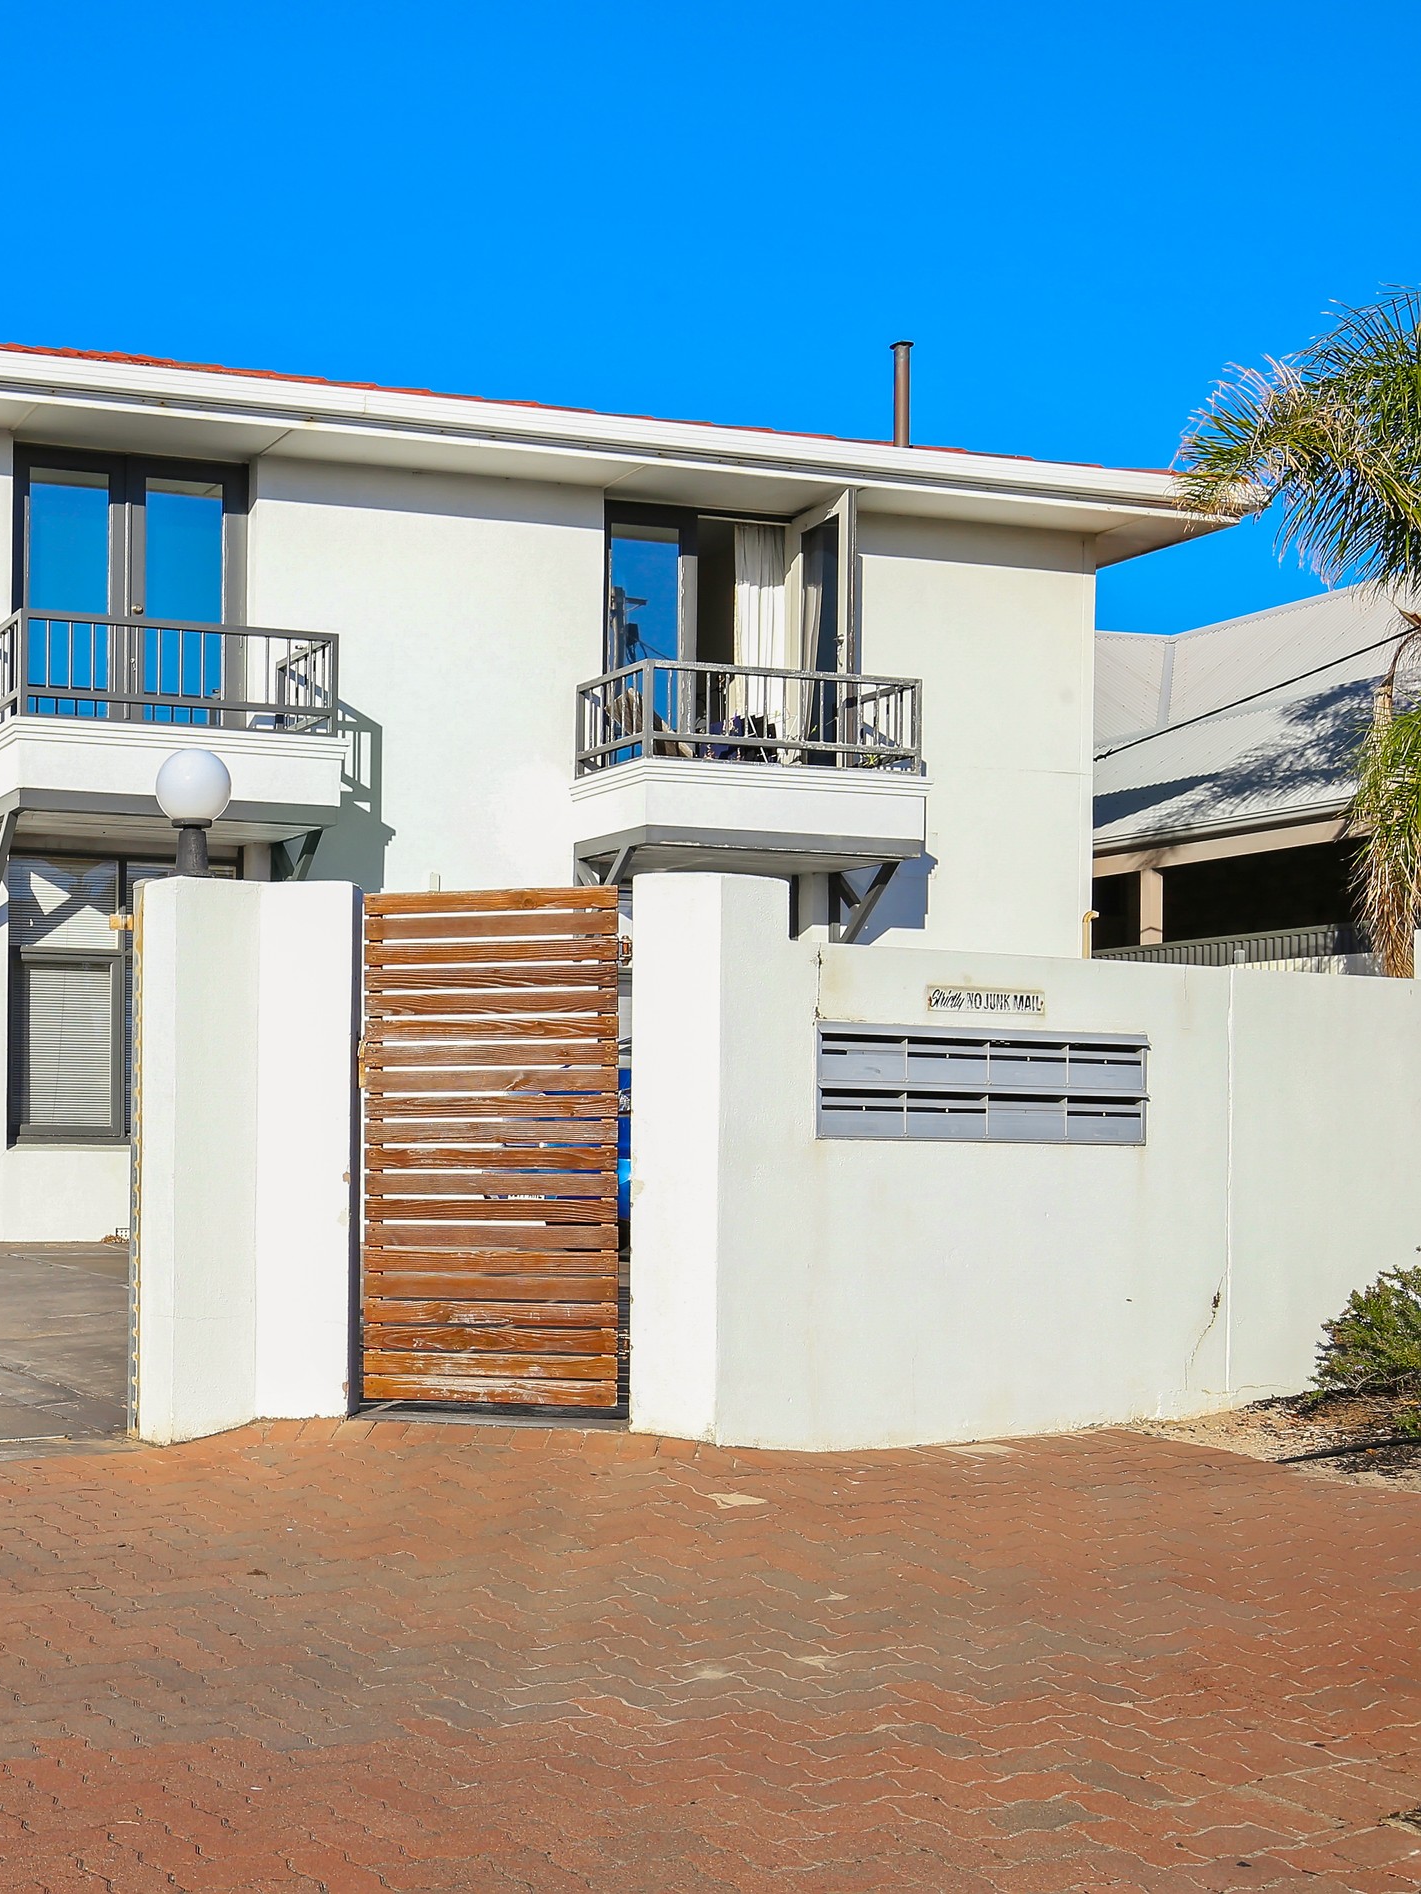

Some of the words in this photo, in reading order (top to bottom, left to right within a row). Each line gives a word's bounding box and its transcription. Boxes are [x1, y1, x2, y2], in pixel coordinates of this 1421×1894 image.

[930, 989, 965, 1011] Strictly
[966, 992, 982, 1009] NO
[983, 993, 1011, 1011] JUNK
[1014, 994, 1041, 1011] MAIL
